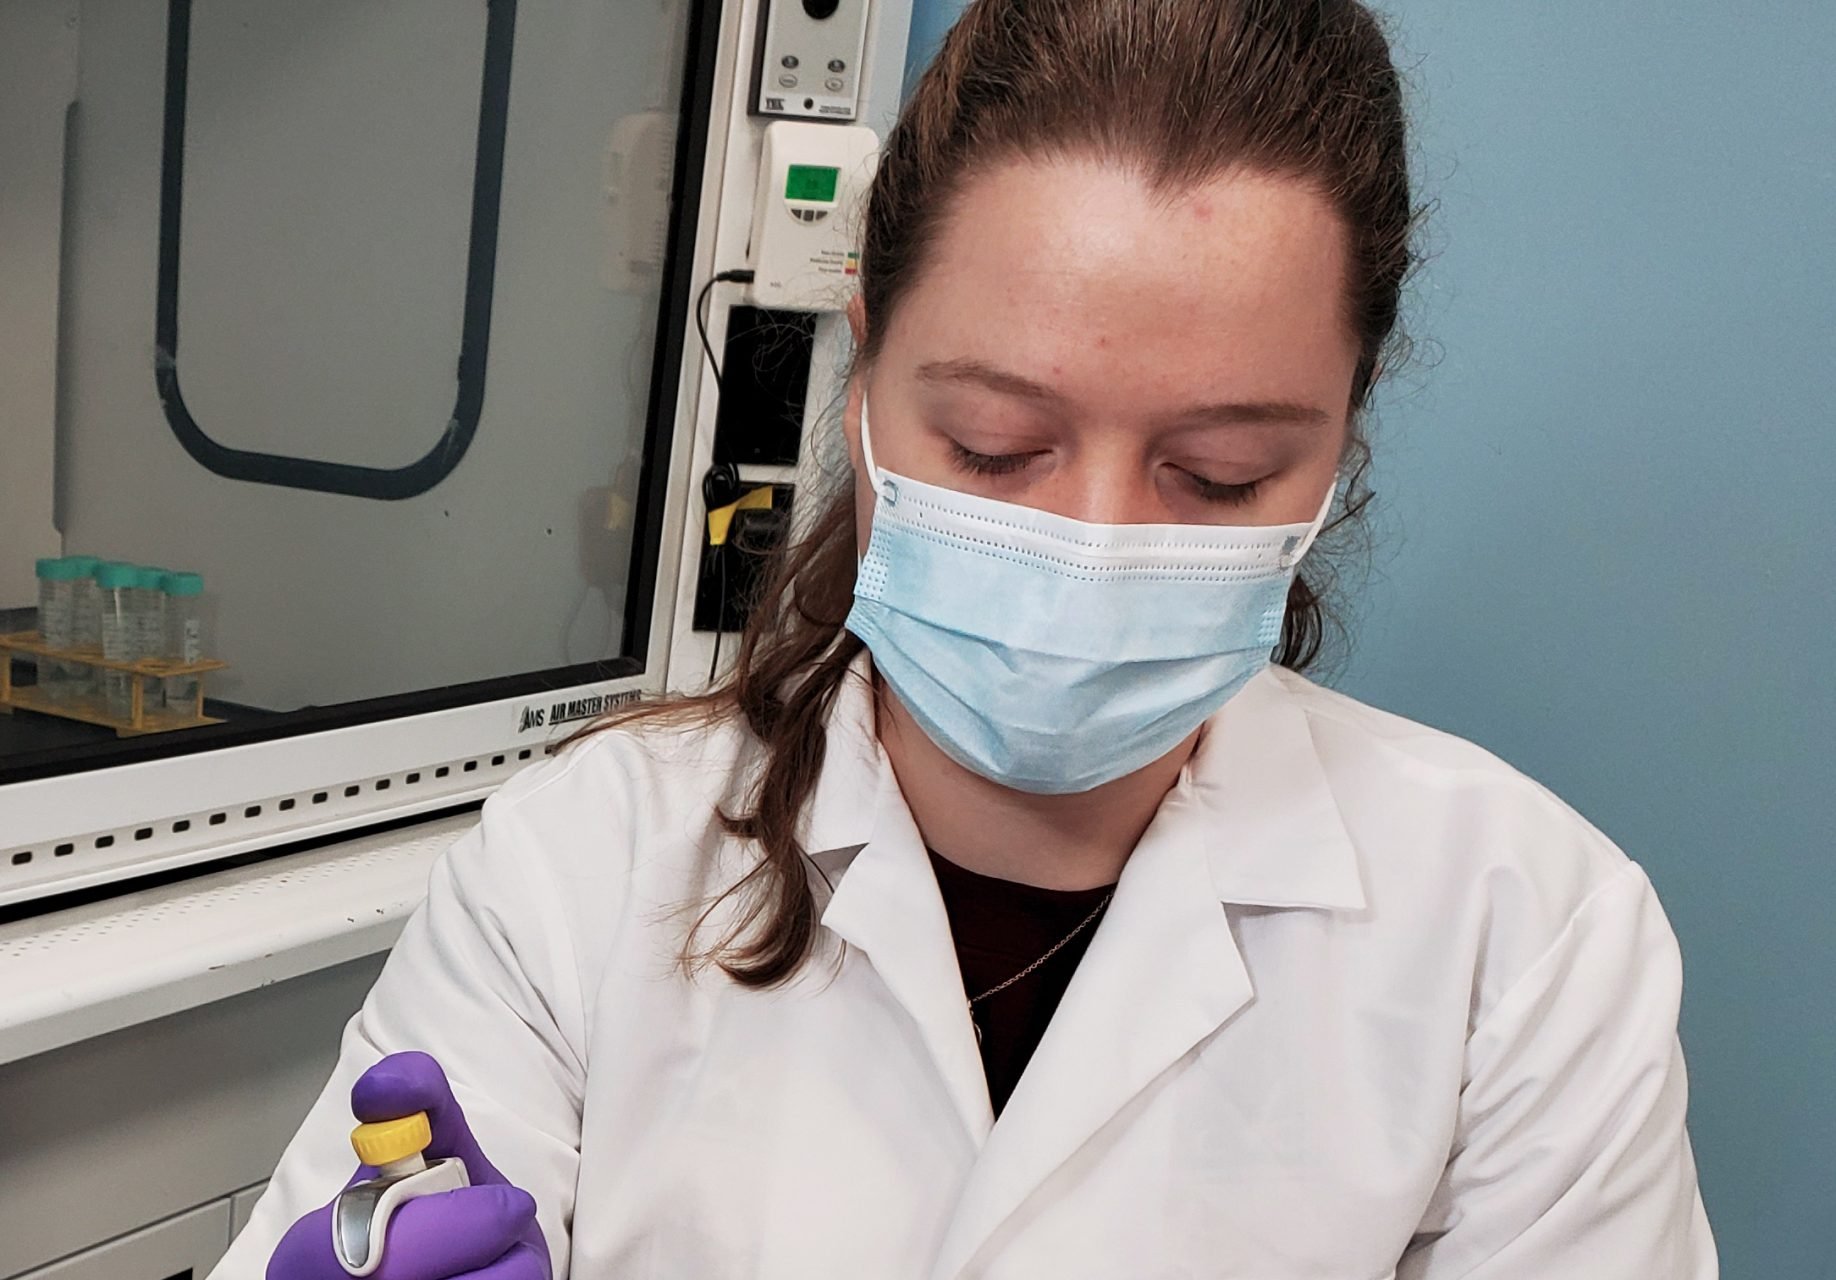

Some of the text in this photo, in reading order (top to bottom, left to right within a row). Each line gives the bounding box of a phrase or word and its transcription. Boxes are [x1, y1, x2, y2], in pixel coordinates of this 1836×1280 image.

[518, 705, 545, 734] AMS
[549, 702, 566, 722] AIR
[567, 696, 603, 718] MASTER
